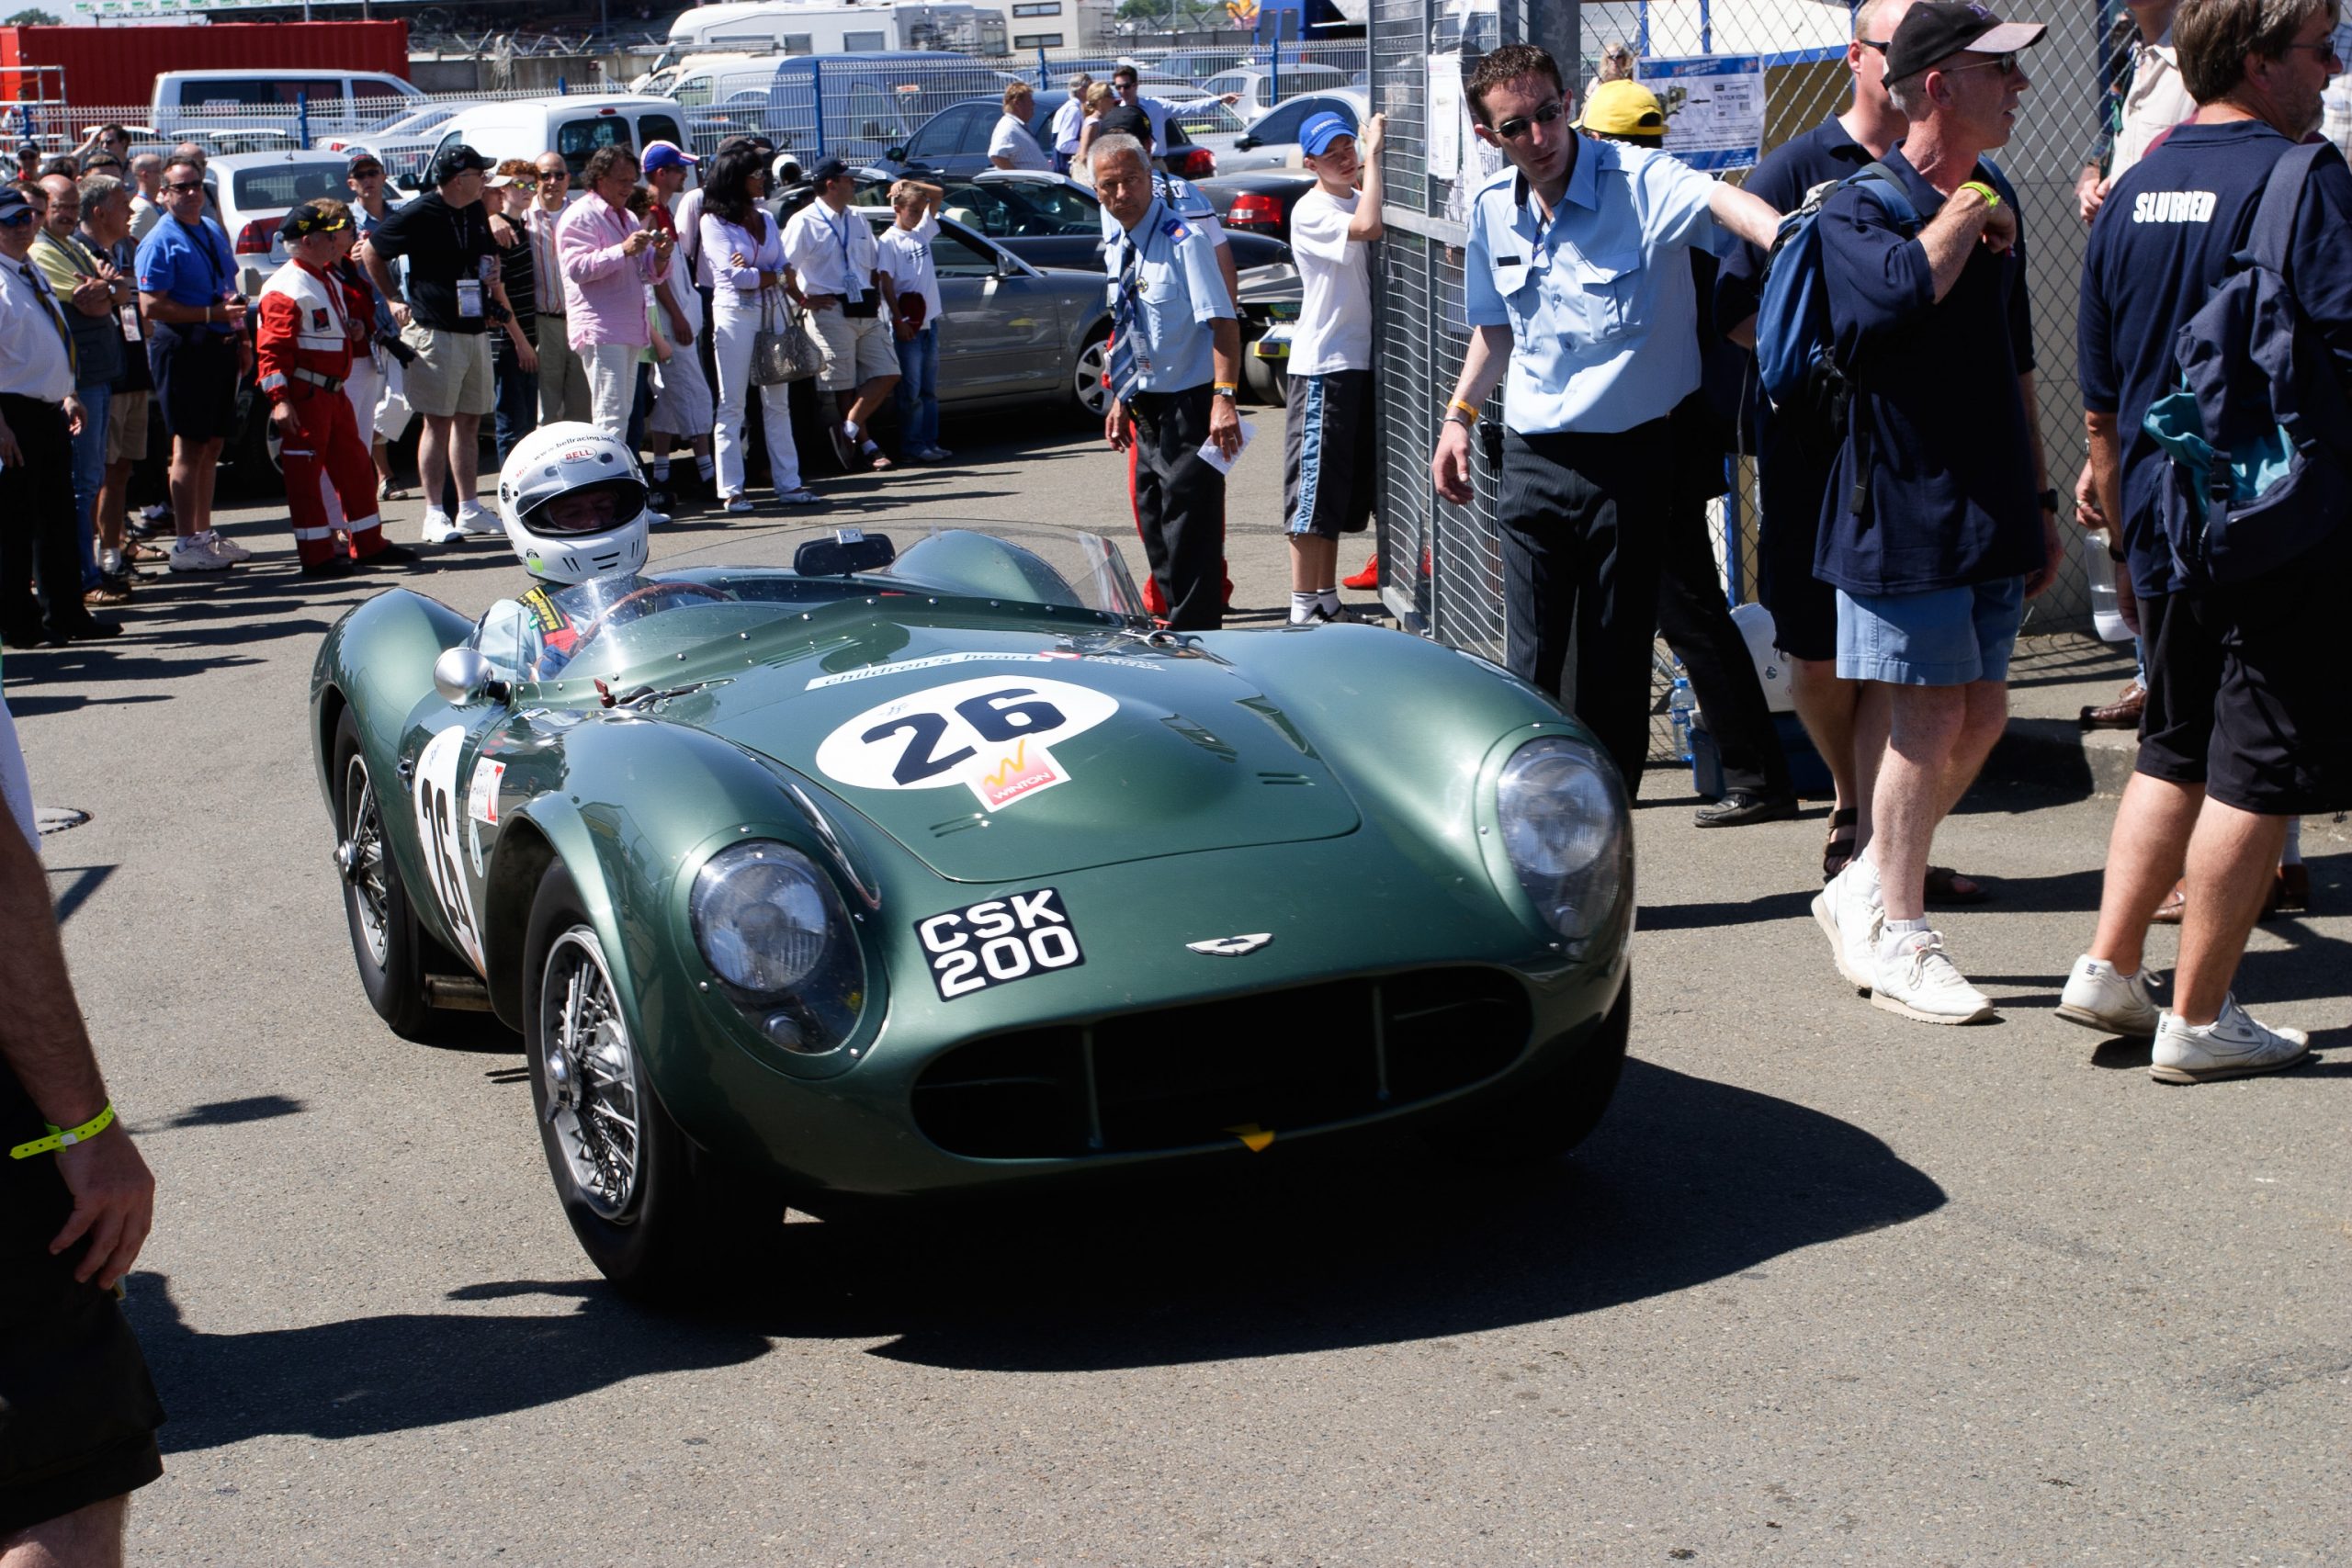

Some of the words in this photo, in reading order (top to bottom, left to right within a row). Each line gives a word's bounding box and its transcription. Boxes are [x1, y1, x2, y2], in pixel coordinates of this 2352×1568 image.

[565, 448, 594, 461] BELL
[824, 656, 953, 685] children's
[963, 653, 1033, 661] heart
[861, 688, 1066, 785] 26
[992, 772, 1051, 800] WINTON
[920, 889, 1066, 953] CSK
[933, 925, 1080, 998] 200
